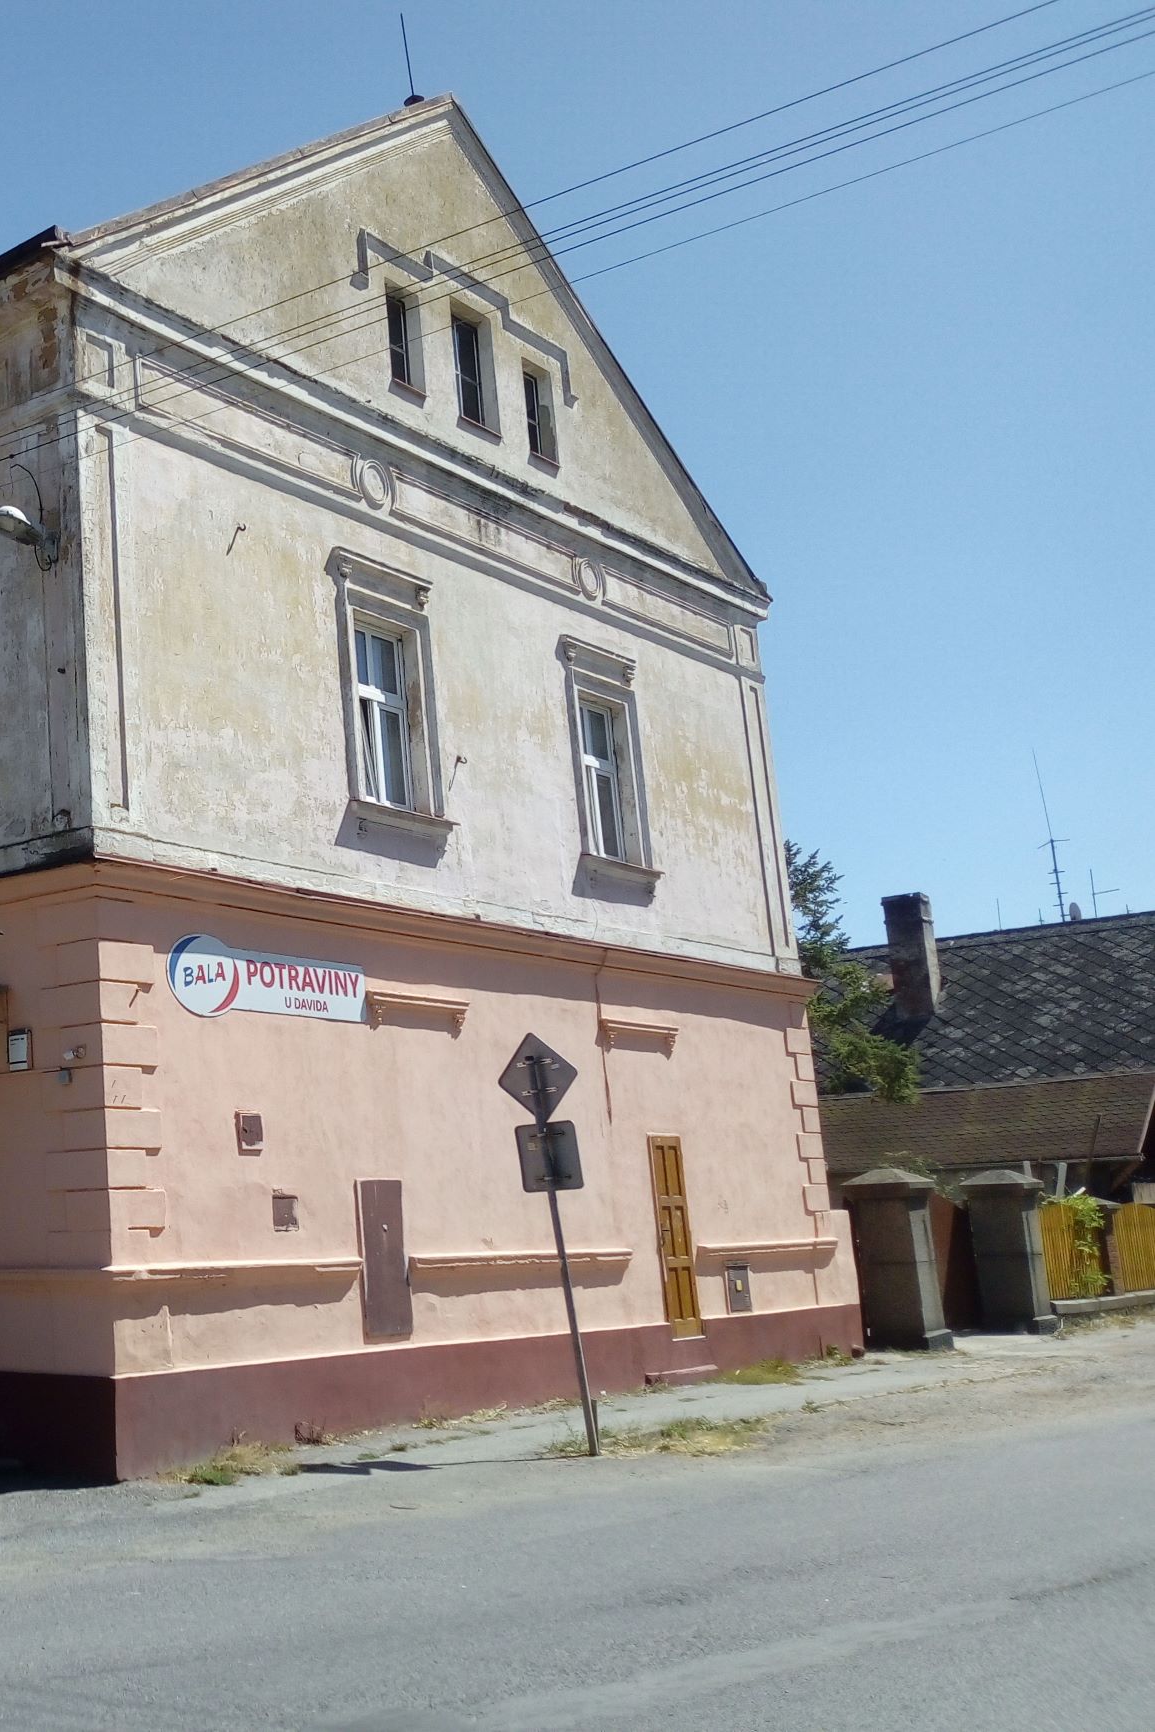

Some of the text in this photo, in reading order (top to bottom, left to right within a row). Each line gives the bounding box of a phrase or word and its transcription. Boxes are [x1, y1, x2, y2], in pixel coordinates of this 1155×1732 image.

[183, 961, 226, 987] BALA
[246, 960, 359, 998] POTRAVINY
[284, 996, 329, 1013] U DAVIDA
